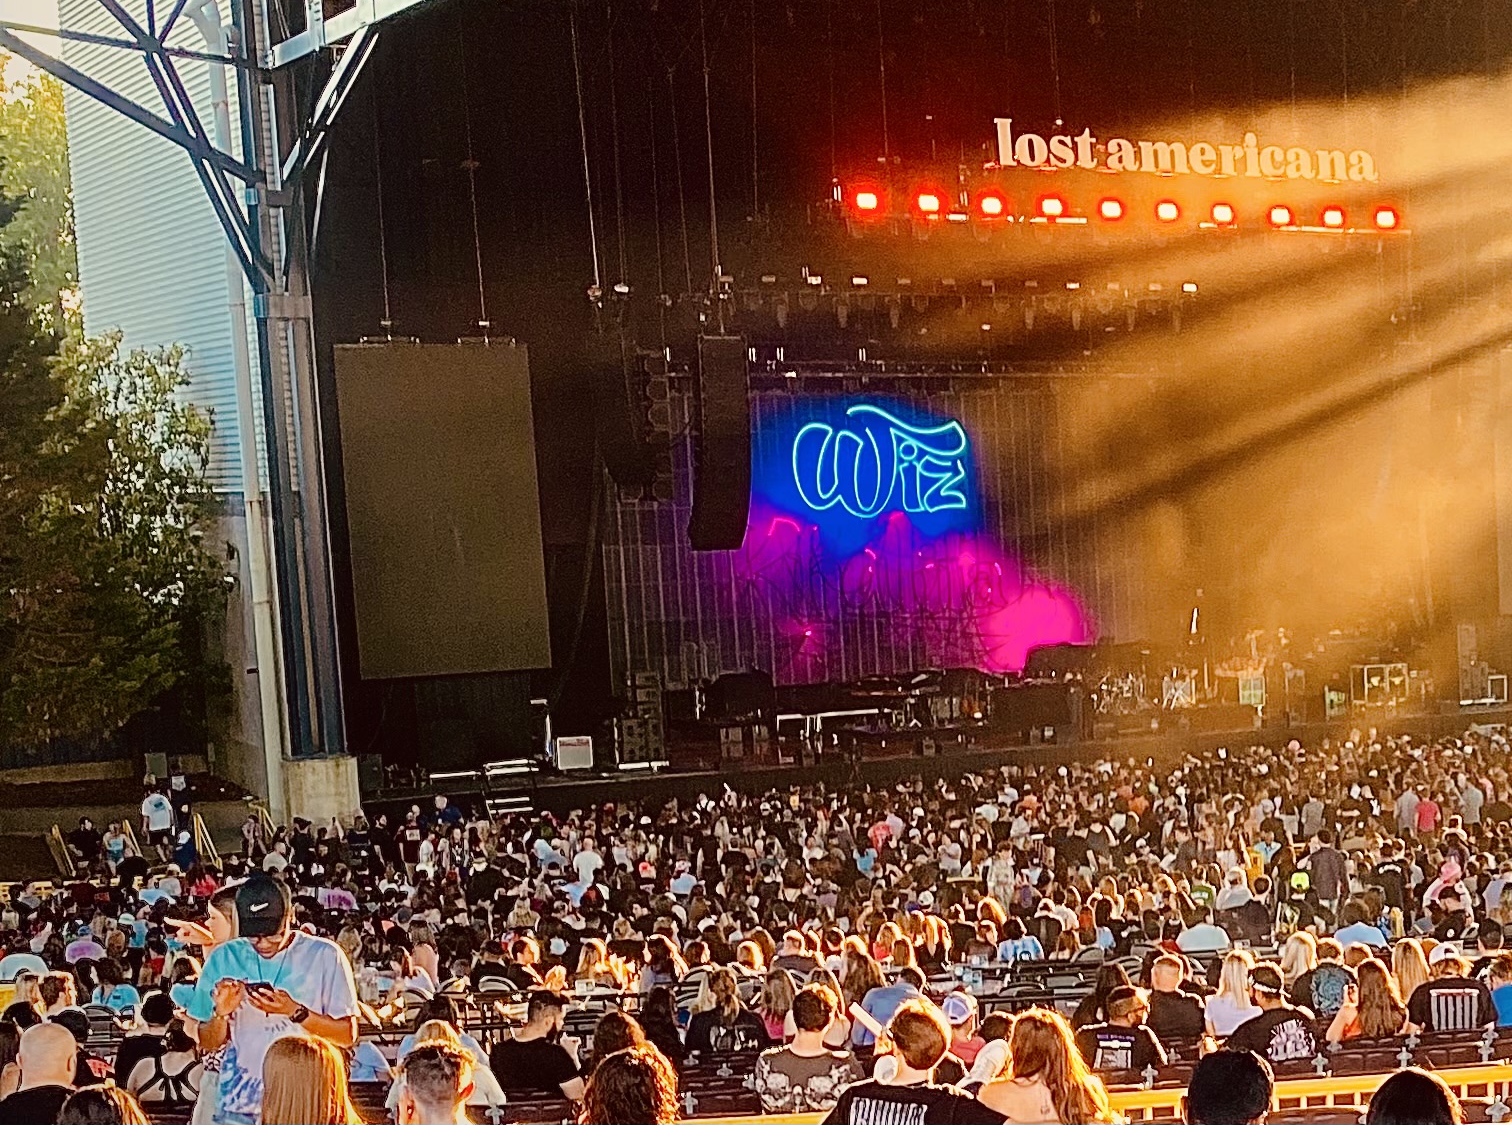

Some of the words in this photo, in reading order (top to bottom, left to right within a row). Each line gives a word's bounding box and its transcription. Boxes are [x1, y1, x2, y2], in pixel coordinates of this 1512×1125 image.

[993, 117, 1098, 169] lost
[1105, 131, 1380, 183] americana
[792, 403, 968, 519] Wiz
